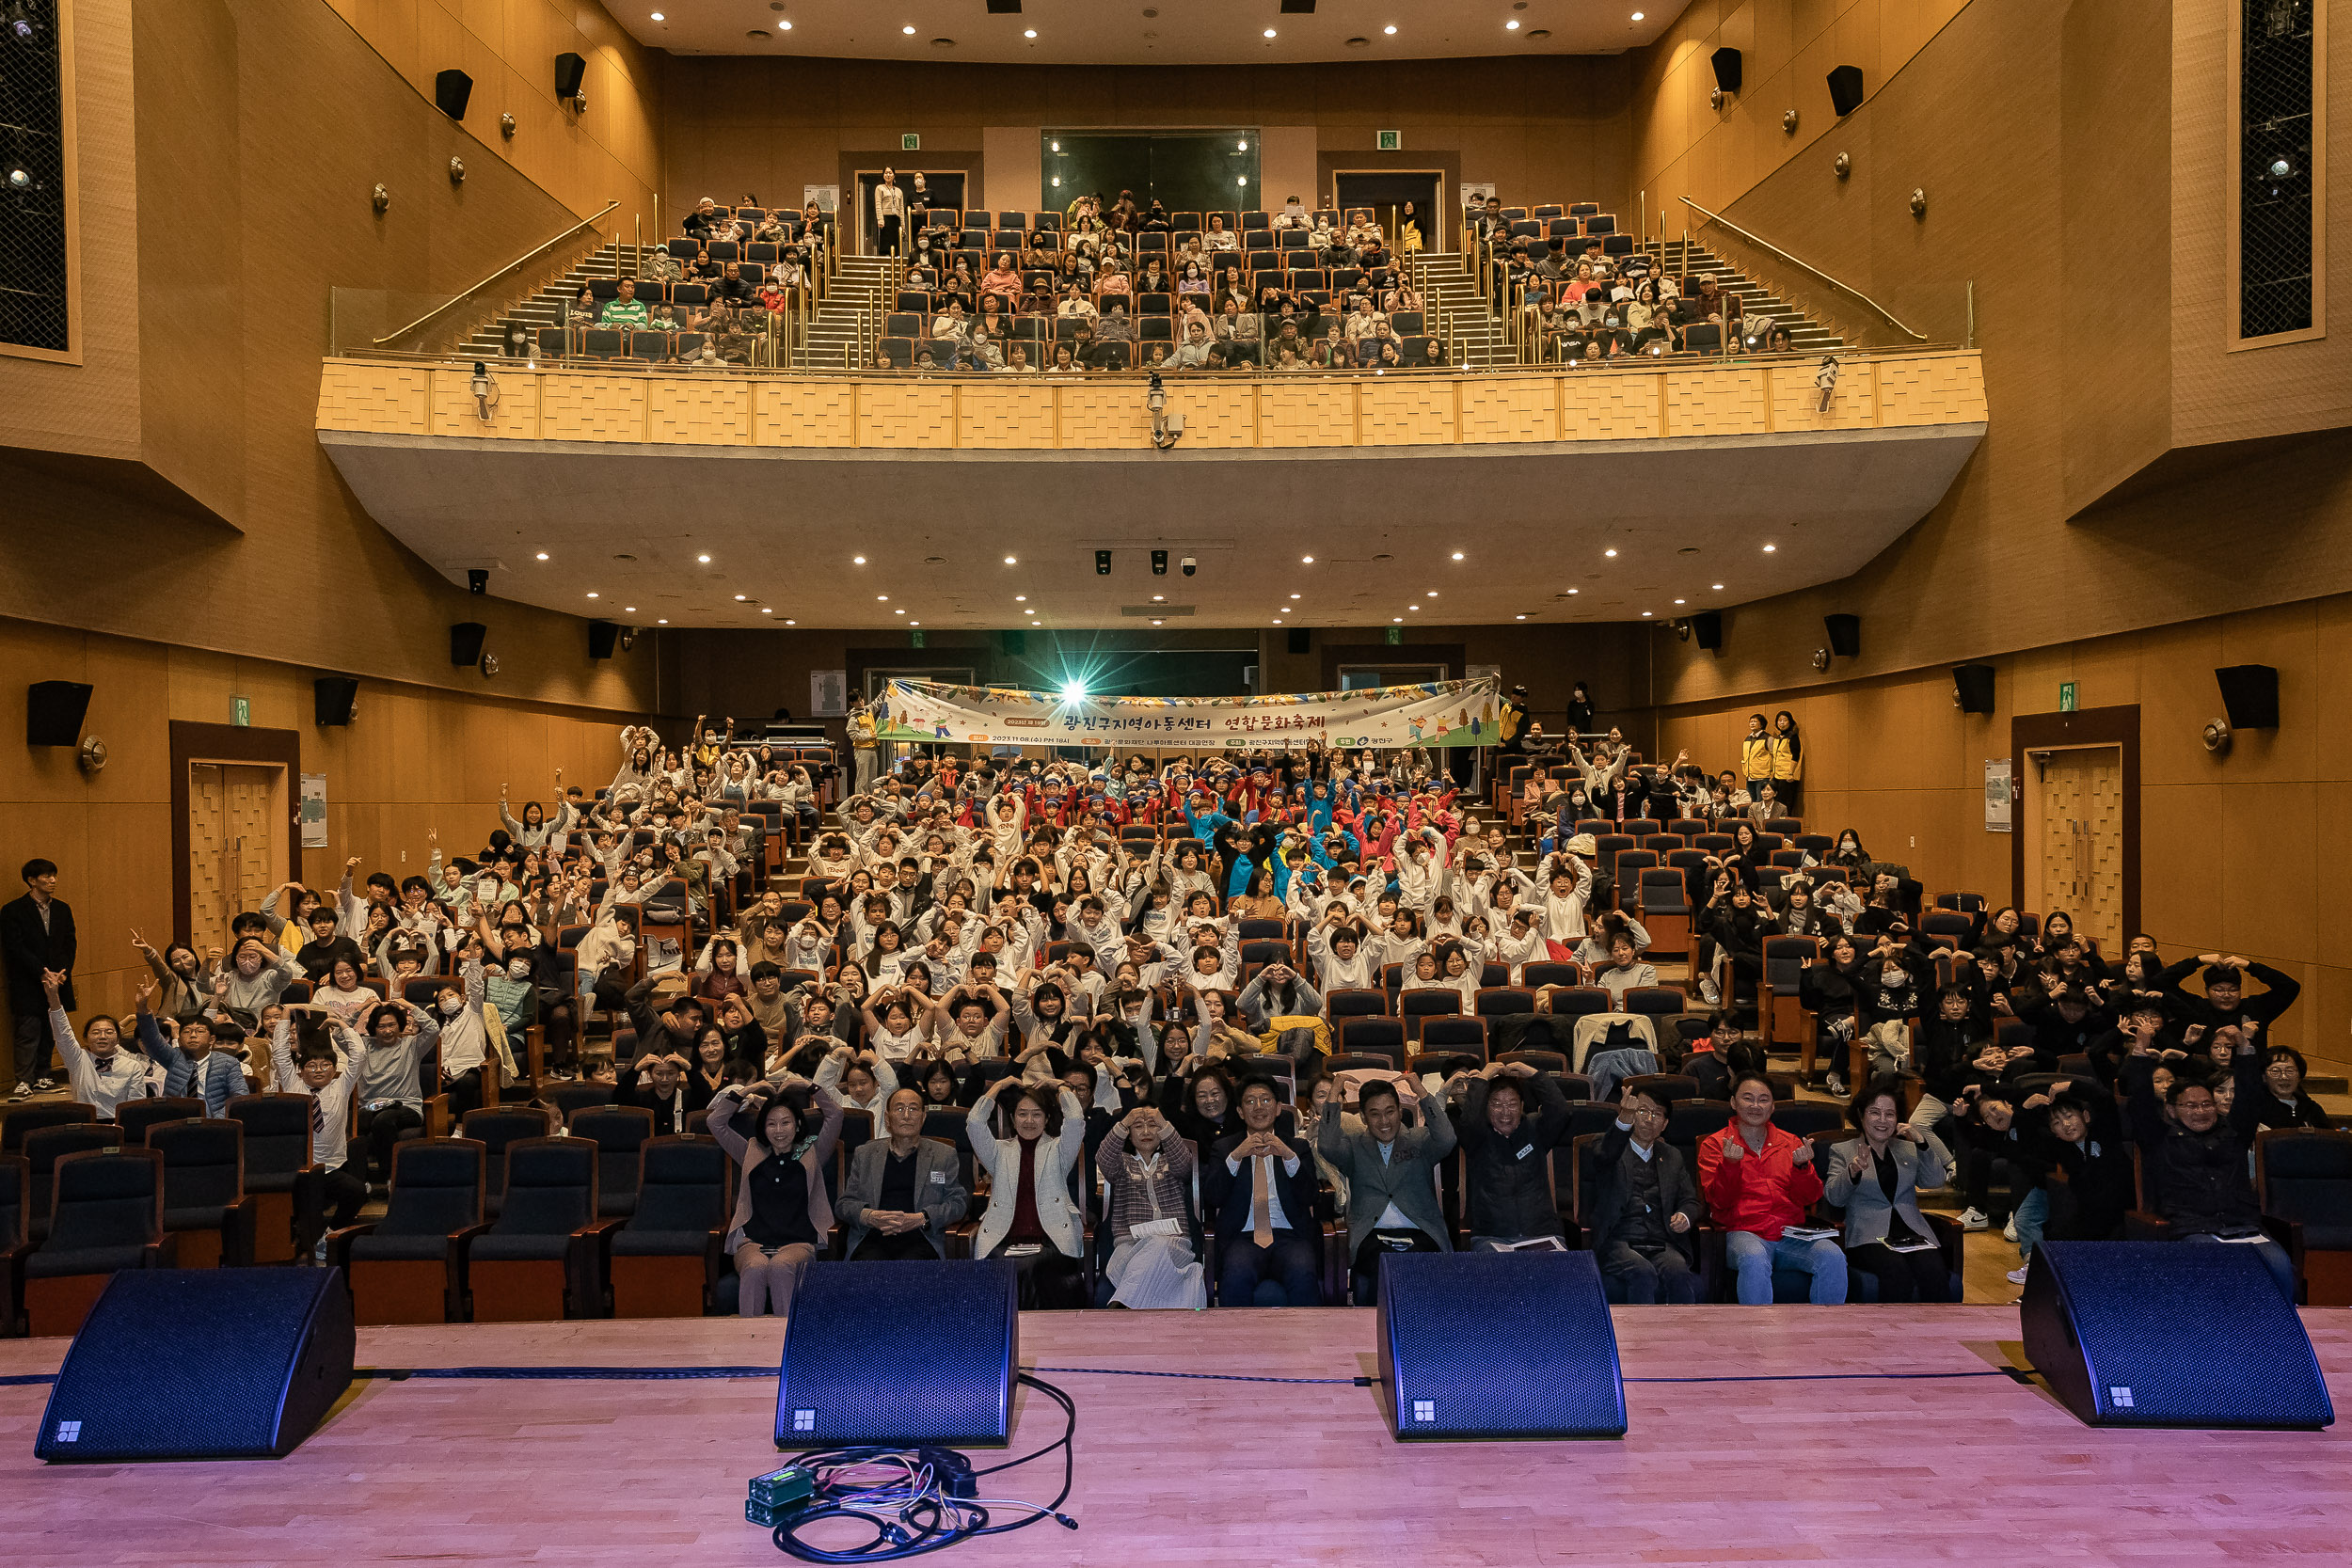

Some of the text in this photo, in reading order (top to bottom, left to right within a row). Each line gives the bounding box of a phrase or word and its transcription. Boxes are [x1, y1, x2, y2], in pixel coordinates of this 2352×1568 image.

[570, 309, 593, 319] LOUIS
[1063, 713, 1326, 732] 광진구지역아동센터 연합문화축제
